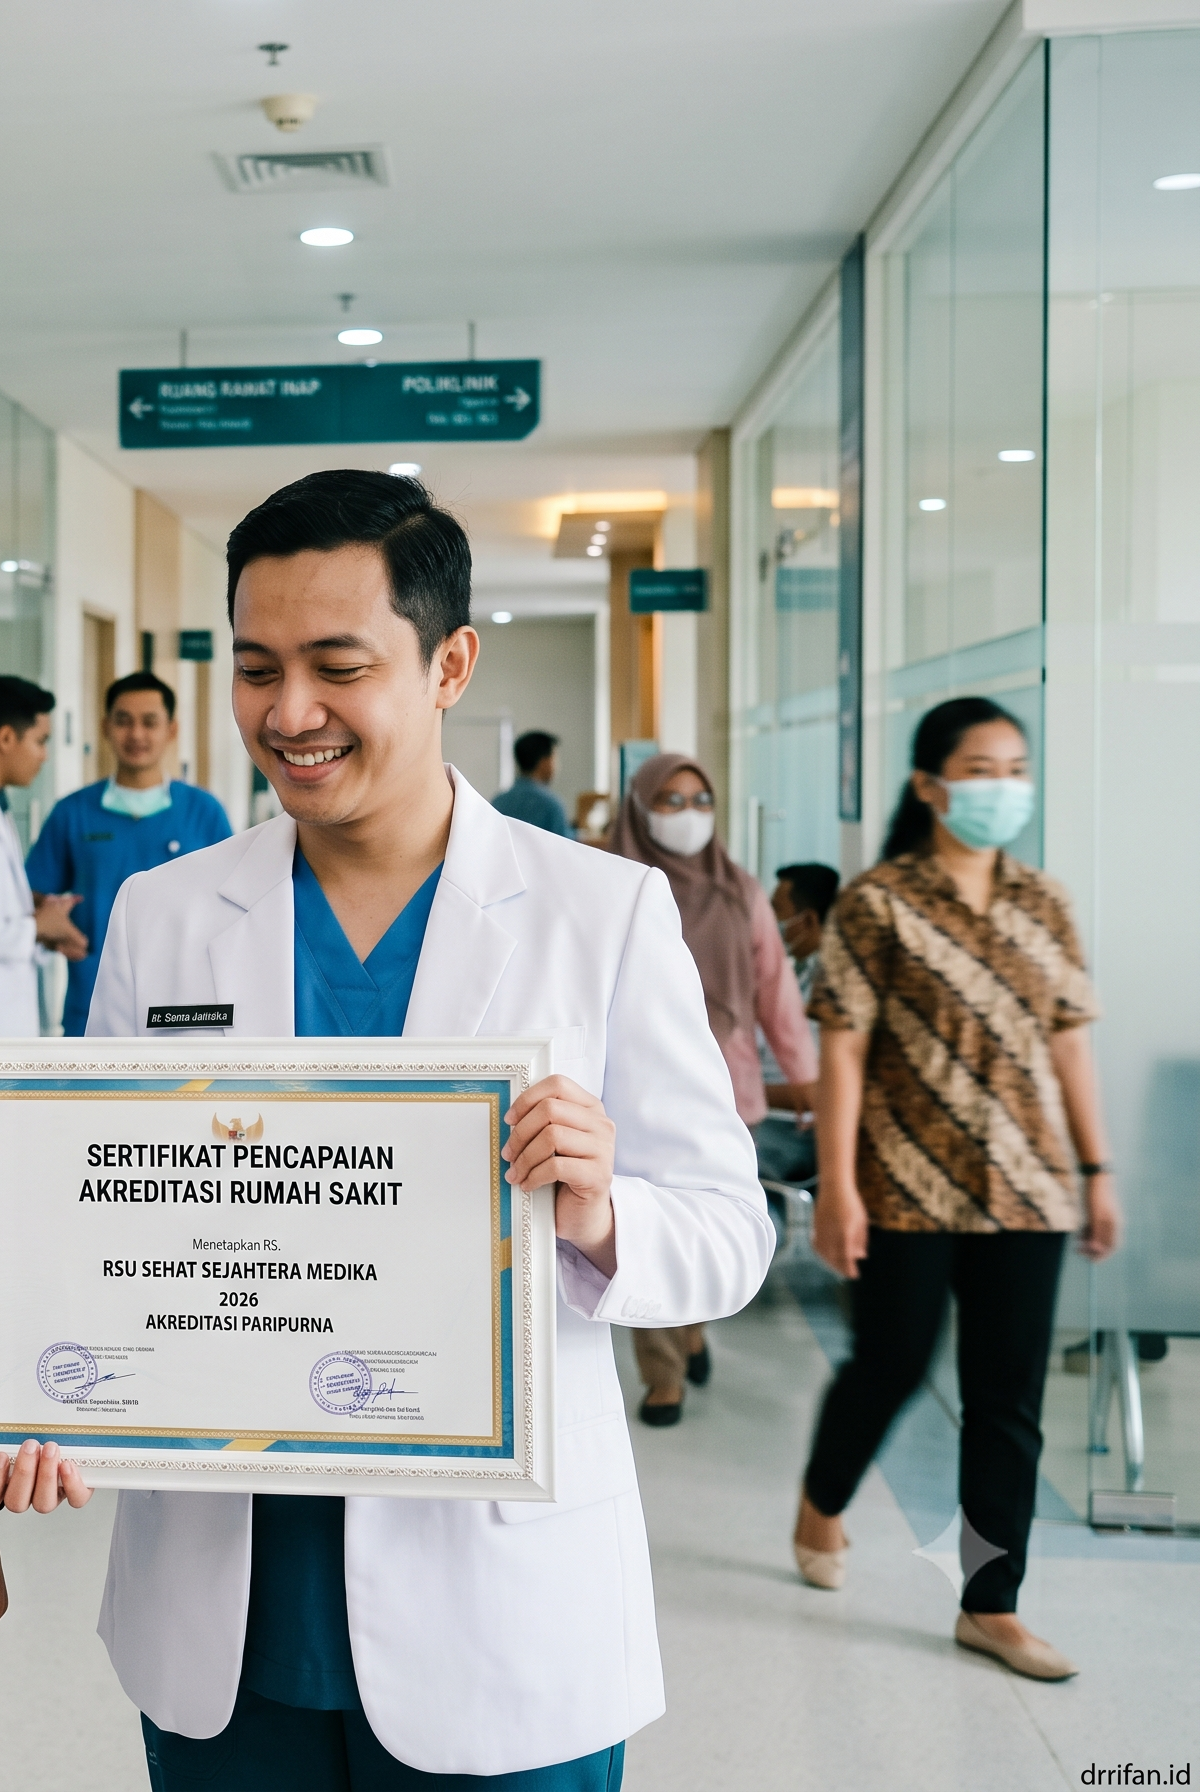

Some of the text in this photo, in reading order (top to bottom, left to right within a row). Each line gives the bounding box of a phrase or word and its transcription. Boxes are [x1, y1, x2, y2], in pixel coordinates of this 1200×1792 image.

[87, 1143, 394, 1170] SERTIFIKAT PENCAPAIAN
[78, 1178, 403, 1206] AKREDITASI RUMAH SAKIT
[192, 1238, 282, 1253] Menetapkan RS.
[103, 1259, 378, 1281] RSU SEHAT SEJAHTERA MEDIKA
[219, 1291, 259, 1308] 2026
[145, 1314, 334, 1333] AKREDITASI PARIPURNA
